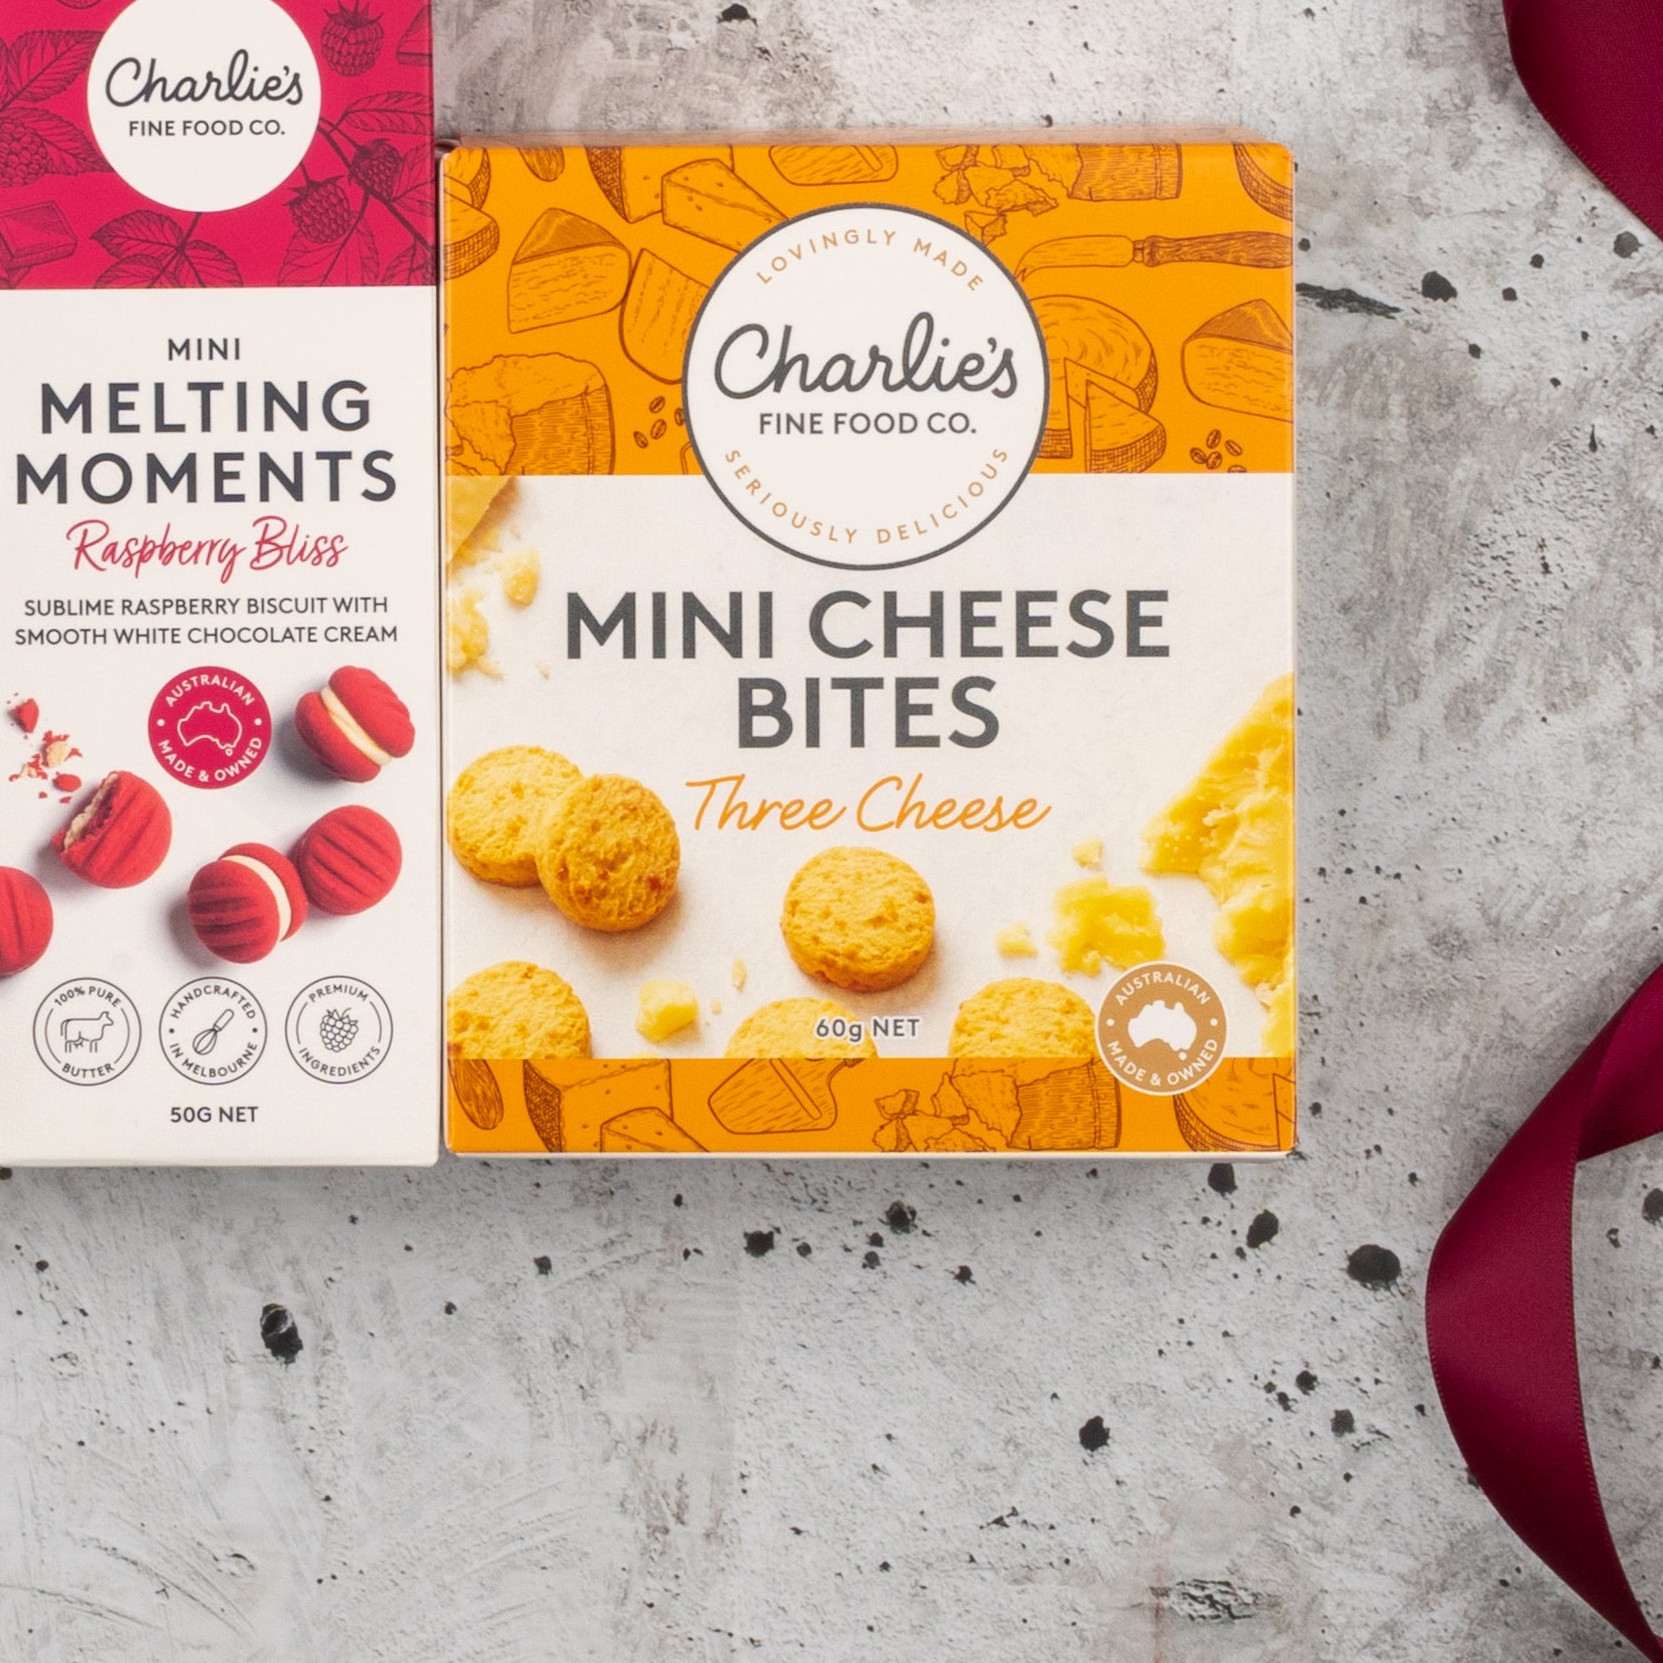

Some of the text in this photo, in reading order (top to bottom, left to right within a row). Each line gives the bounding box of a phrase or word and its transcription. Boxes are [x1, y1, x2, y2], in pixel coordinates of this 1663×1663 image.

[106, 49, 303, 107] Charlie's
[130, 120, 285, 136] FINE FOOD CO.
[755, 229, 984, 292] LOVINGLY MADE
[168, 338, 239, 361] MINI
[714, 312, 1017, 399] Charlie's
[42, 380, 369, 434] MELTING
[760, 412, 976, 434] FINE FOOD CO.
[17, 450, 396, 504] MOMENTS
[725, 447, 1008, 545] SERIOUSLY DELICIOUS
[66, 516, 348, 584] Raspberry Bliss
[25, 597, 387, 616] SUBLIME RASPBERRY BISCUIT WITH
[567, 589, 1169, 659] MINI CHEESE
[16, 626, 397, 645] SMOOTH WHITE CHOCOLATE CREAM
[165, 674, 255, 707] AUSTRALIAN
[738, 676, 999, 748] BITES
[158, 738, 262, 782] MADE & OWNED
[686, 773, 1051, 832] Three Cheese
[54, 986, 122, 1007] 100% PURE
[170, 985, 256, 1019] HANDCRAFTED
[308, 984, 369, 1003] PREMIUM
[1115, 971, 1211, 1006] AUSTRALIAN
[815, 1018, 920, 1042] 60g NET
[62, 1063, 115, 1078] BUTTER
[170, 1041, 257, 1078] IN MELBOURNE
[299, 1046, 381, 1077] INGREDIENTS
[1107, 1038, 1218, 1086] MADE & OWNED
[171, 1106, 258, 1123] 50G NET
